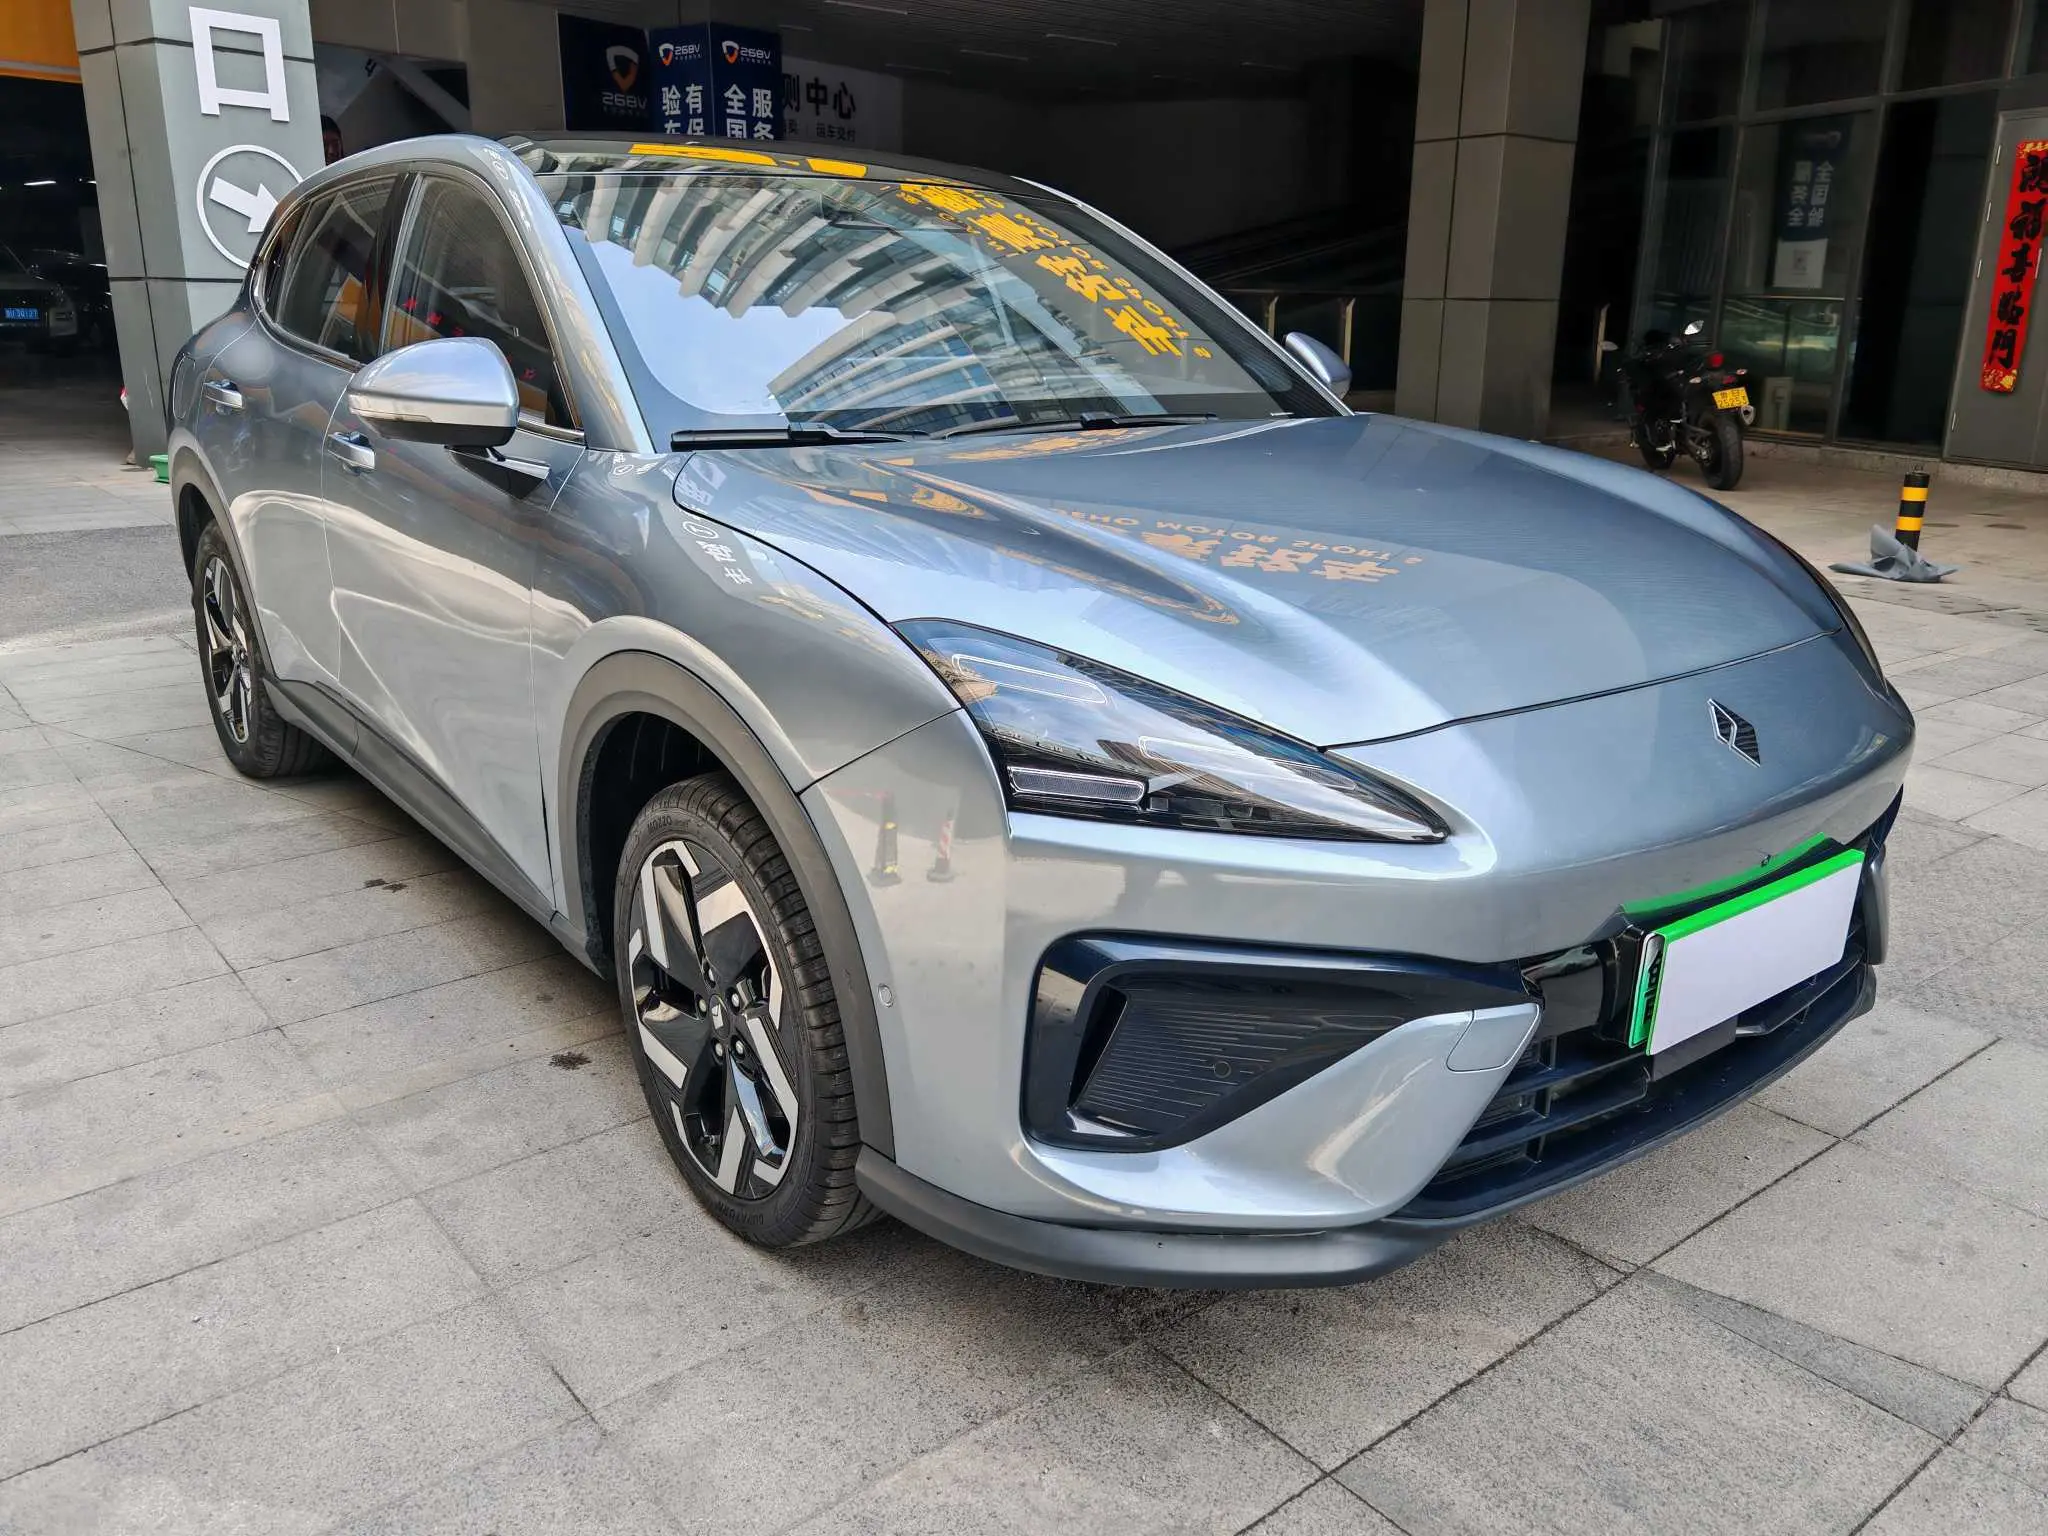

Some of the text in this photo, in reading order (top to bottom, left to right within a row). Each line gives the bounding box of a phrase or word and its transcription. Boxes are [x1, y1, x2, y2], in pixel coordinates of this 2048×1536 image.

[674, 43, 700, 56] 268V
[740, 47, 771, 60] 268V
[601, 91, 648, 109] 268V
